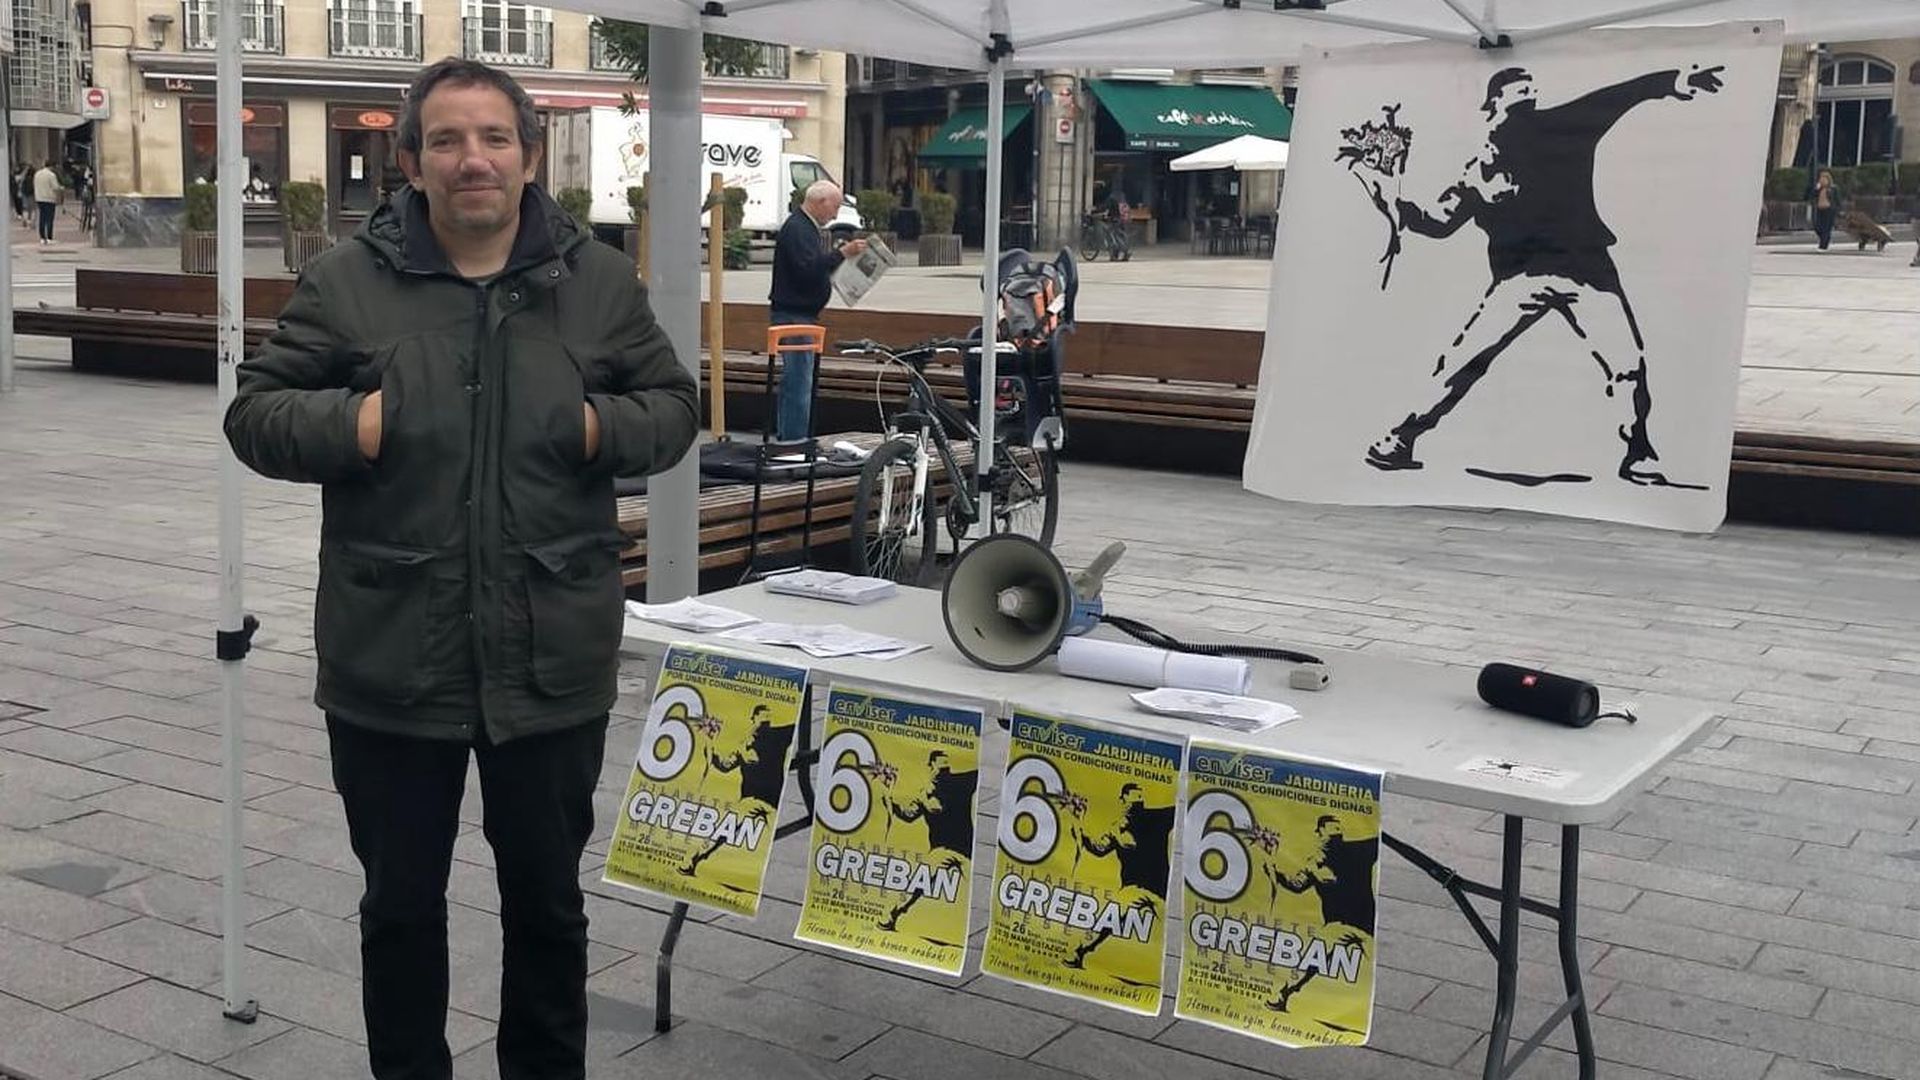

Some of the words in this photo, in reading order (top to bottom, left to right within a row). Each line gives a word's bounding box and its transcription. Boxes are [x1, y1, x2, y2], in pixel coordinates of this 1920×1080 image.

[637, 683, 707, 782] 6
[877, 724, 938, 743] CONDICIONES
[940, 737, 975, 750] DIGNAS
[1015, 739, 1033, 750] POR
[1036, 744, 1062, 758] UNAS
[1064, 751, 1132, 774] CONDICIONES
[1134, 767, 1174, 785] DIGNAS
[1093, 743, 1175, 770] JARDINERIA
[816, 729, 877, 835] 6
[1195, 774, 1216, 785] POR
[1220, 778, 1249, 791] UNAS
[1252, 784, 1328, 807] CONDICIONES
[1329, 799, 1373, 815] DIGNAS
[1196, 753, 1274, 783] enviser
[1285, 774, 1374, 800] JARDINERIA
[628, 790, 766, 851] GREBAN
[998, 754, 1065, 864] 6
[815, 842, 961, 903] GREBAN
[1184, 788, 1257, 901] 6
[998, 873, 1155, 944] GREBAN
[1012, 921, 1026, 934] 26
[1189, 911, 1364, 984] GREBAN
[1212, 961, 1226, 974] 26
